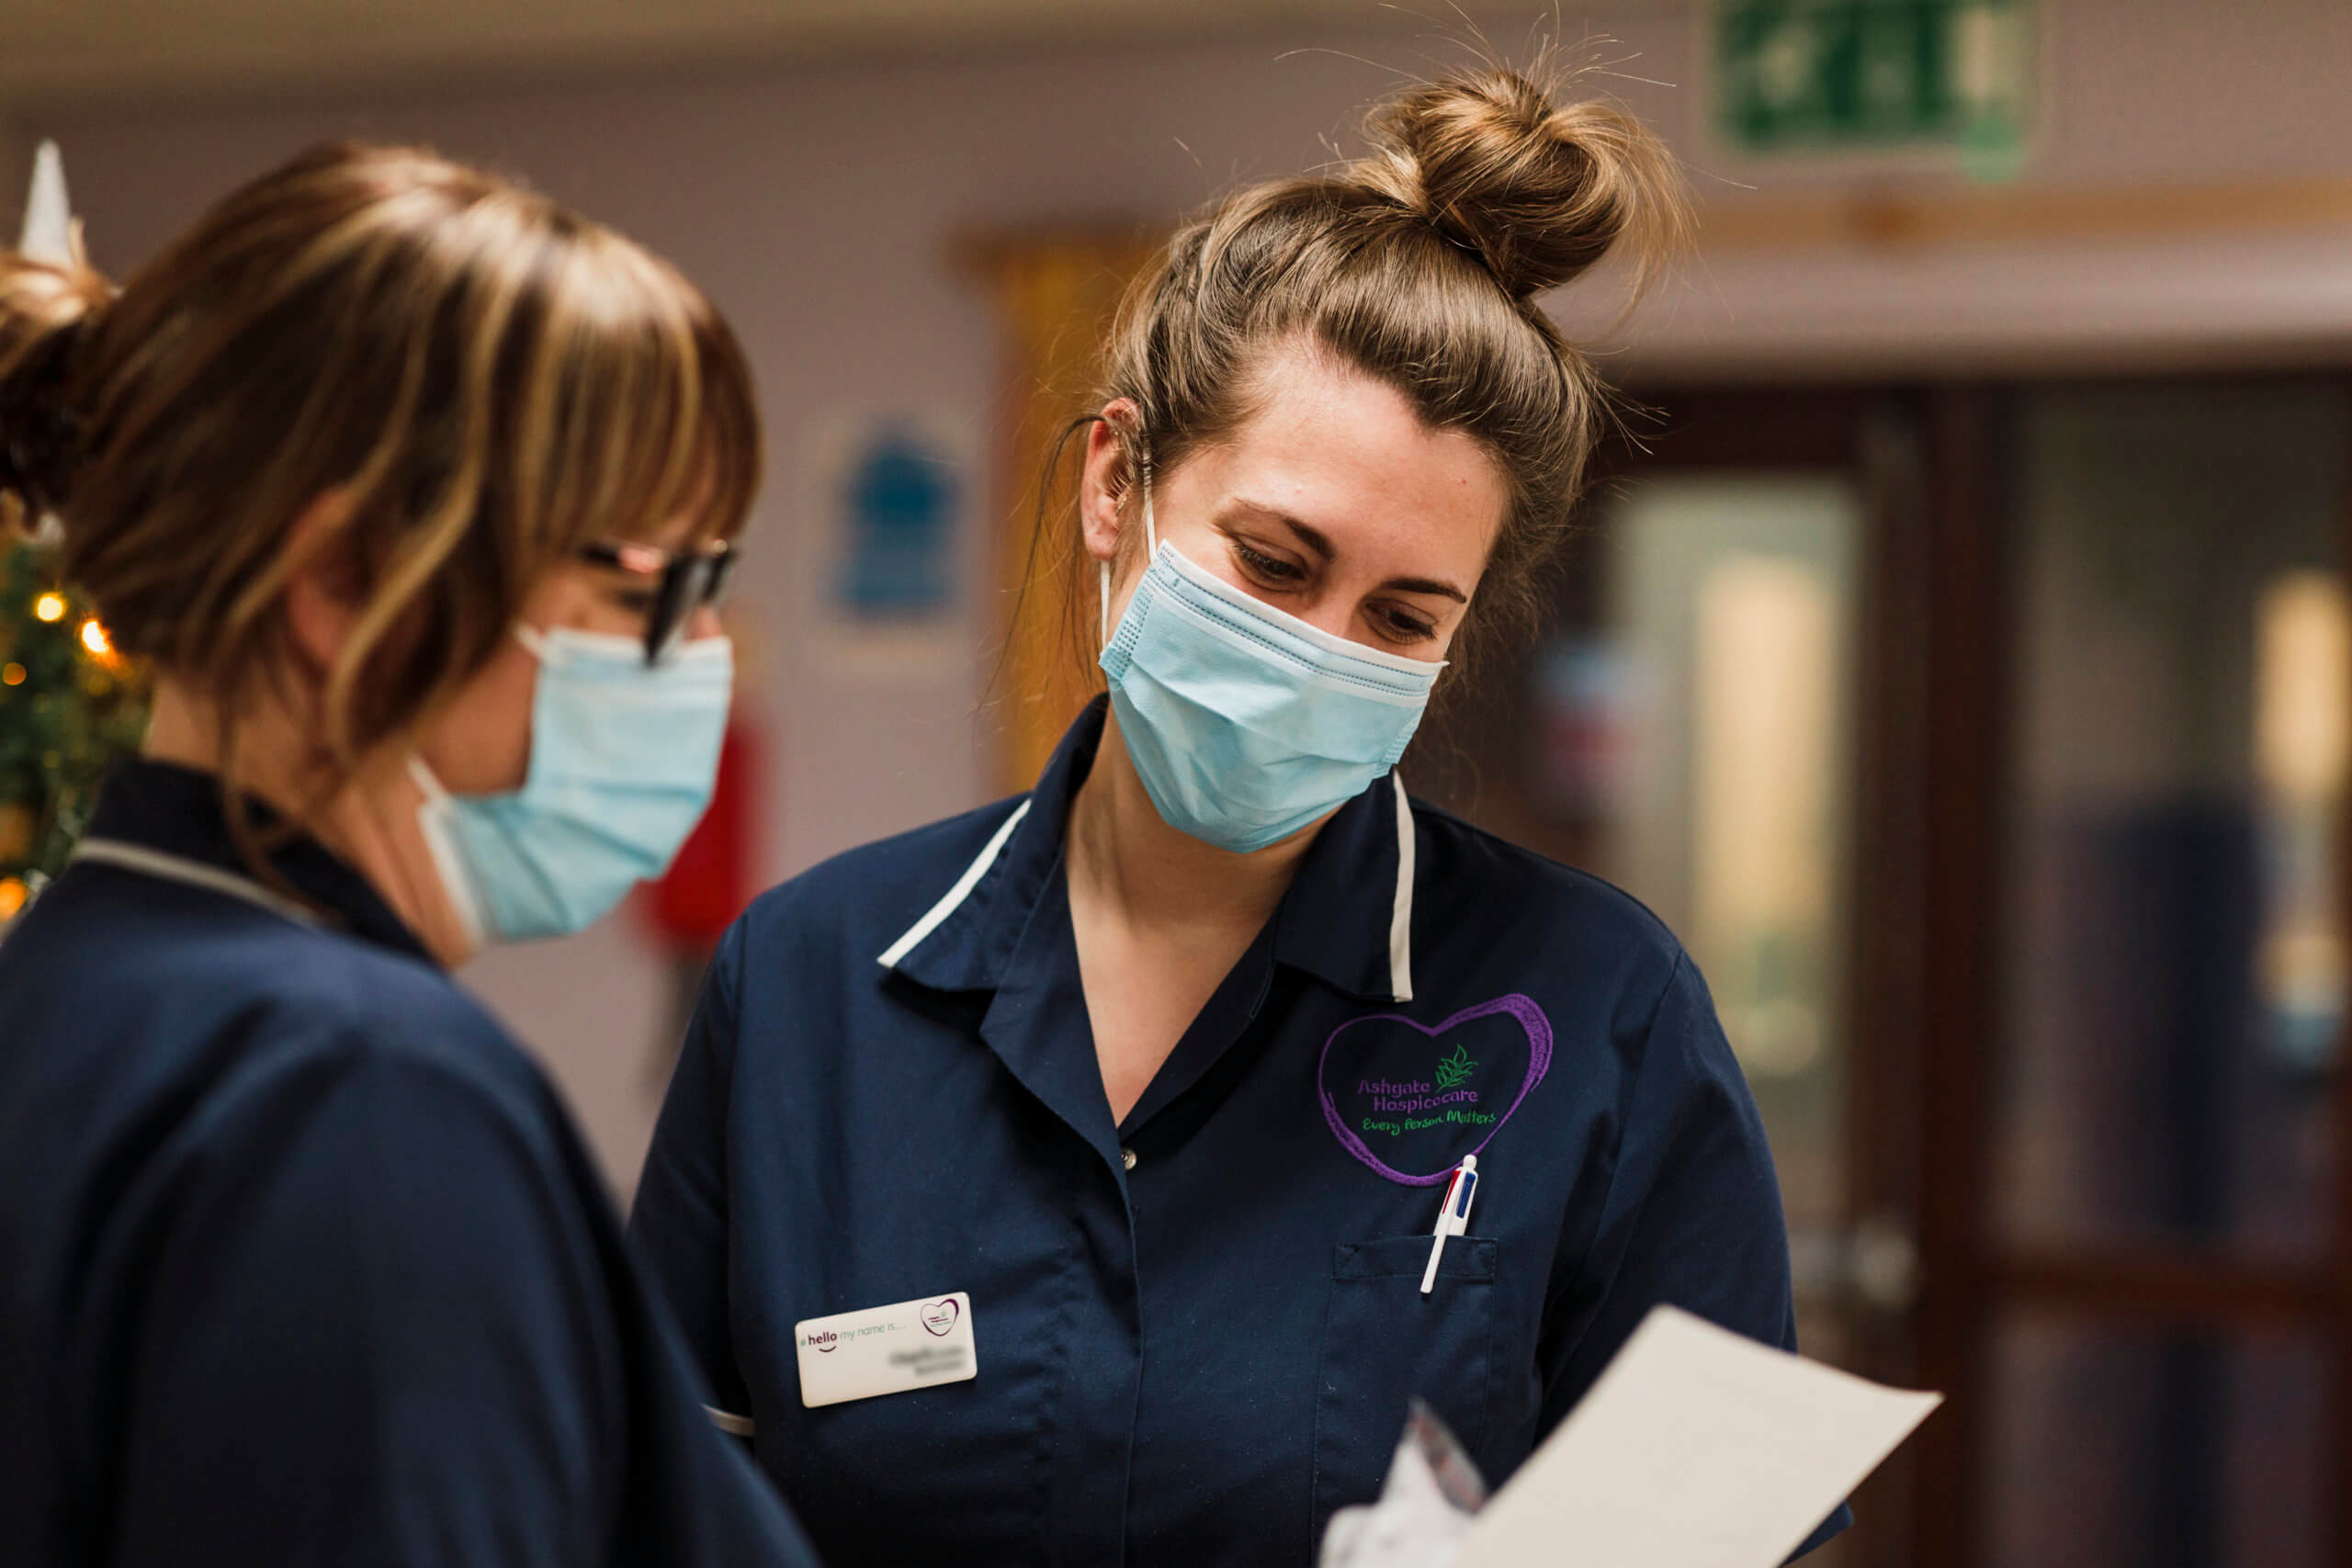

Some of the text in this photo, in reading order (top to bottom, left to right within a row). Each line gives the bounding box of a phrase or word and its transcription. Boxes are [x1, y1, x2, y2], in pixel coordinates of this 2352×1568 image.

[1358, 1078, 1431, 1099] Ashgate
[1374, 1089, 1478, 1114] Hospicecare
[1363, 1110, 1497, 1136] Every Person Matters
[840, 1330, 855, 1341] my
[857, 1325, 886, 1337] name
